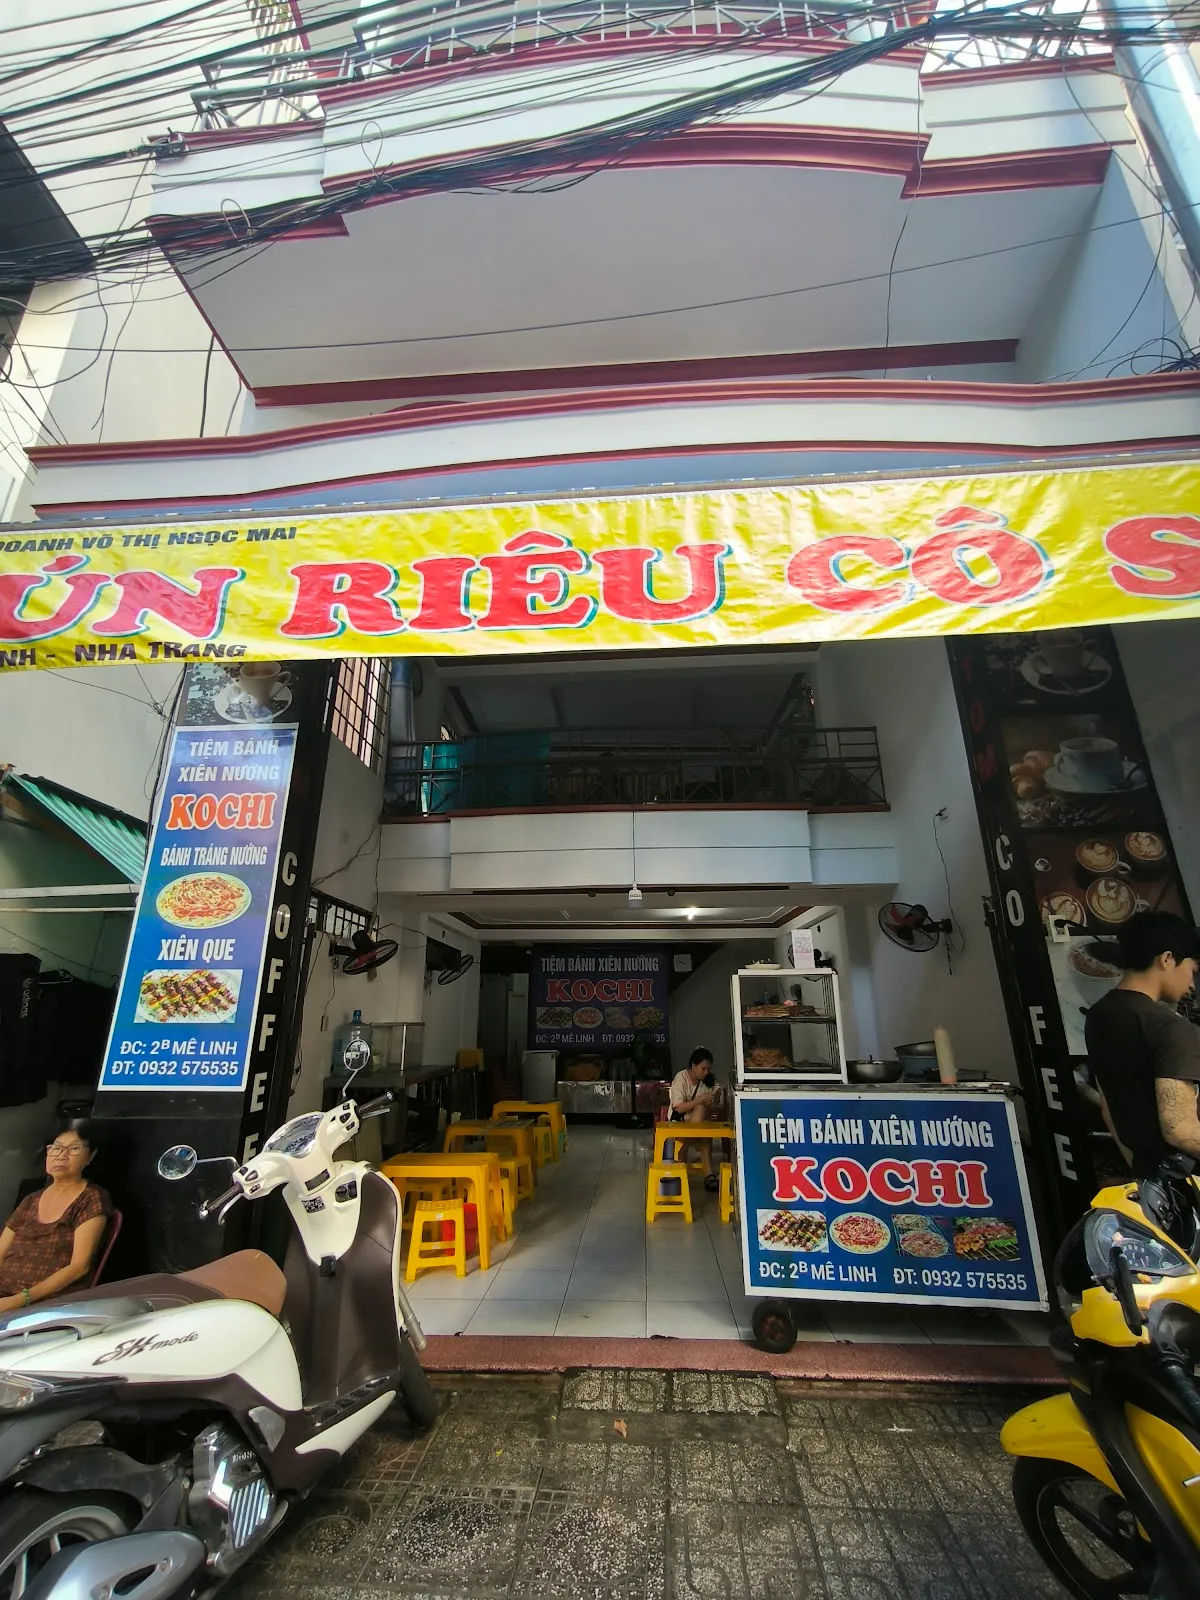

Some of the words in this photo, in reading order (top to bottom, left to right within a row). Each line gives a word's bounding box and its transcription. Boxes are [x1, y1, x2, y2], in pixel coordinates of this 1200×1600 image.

[81, 532, 115, 550] VÕ
[122, 533, 161, 552] THỊ
[167, 528, 240, 547] NGỌC
[246, 526, 297, 543] MAI
[281, 530, 735, 639] RIÊU
[786, 505, 1055, 614] CÔ
[75, 644, 136, 662] NHA
[148, 641, 247, 660] TRANG
[190, 740, 229, 760] TIỆM
[233, 738, 279, 756] BÁNH
[178, 764, 218, 783] XIÊN
[221, 763, 280, 782] NƯỚNG
[165, 792, 277, 830] KOCHI
[160, 843, 191, 866] BÁNH
[193, 843, 228, 866] TRÁNG
[229, 843, 268, 866] NƯỚNG
[157, 934, 198, 961] XIÊN
[201, 938, 236, 963] QUE
[541, 955, 565, 975] TIỆM
[567, 955, 596, 972] BÁNH
[598, 955, 622, 972] XIÊN
[624, 955, 659, 972] NƯỚNG
[546, 978, 655, 1003] KOCHI
[120, 1041, 147, 1055] ĐC:
[172, 1038, 198, 1055] MÊ
[200, 1041, 238, 1055] LINH
[561, 1031, 574, 1043] MÊ
[575, 1034, 595, 1043] LINH
[111, 1061, 135, 1076] ĐT:
[139, 1061, 177, 1076] 0932
[180, 1061, 239, 1076] 575535
[757, 1112, 806, 1150] TIỆM
[810, 1113, 865, 1145] BÁNH
[870, 1114, 917, 1146] XIÊN
[921, 1115, 994, 1148] NƯỚNG
[770, 1156, 993, 1208] KOCHI
[759, 1261, 786, 1279] ĐC:
[811, 1262, 836, 1282] MÊ
[838, 1266, 877, 1283] LINH
[893, 1268, 919, 1286] ĐT:
[921, 1269, 963, 1288] 0932
[966, 1271, 1027, 1291] 575535
[149, 1331, 199, 1351] mode
